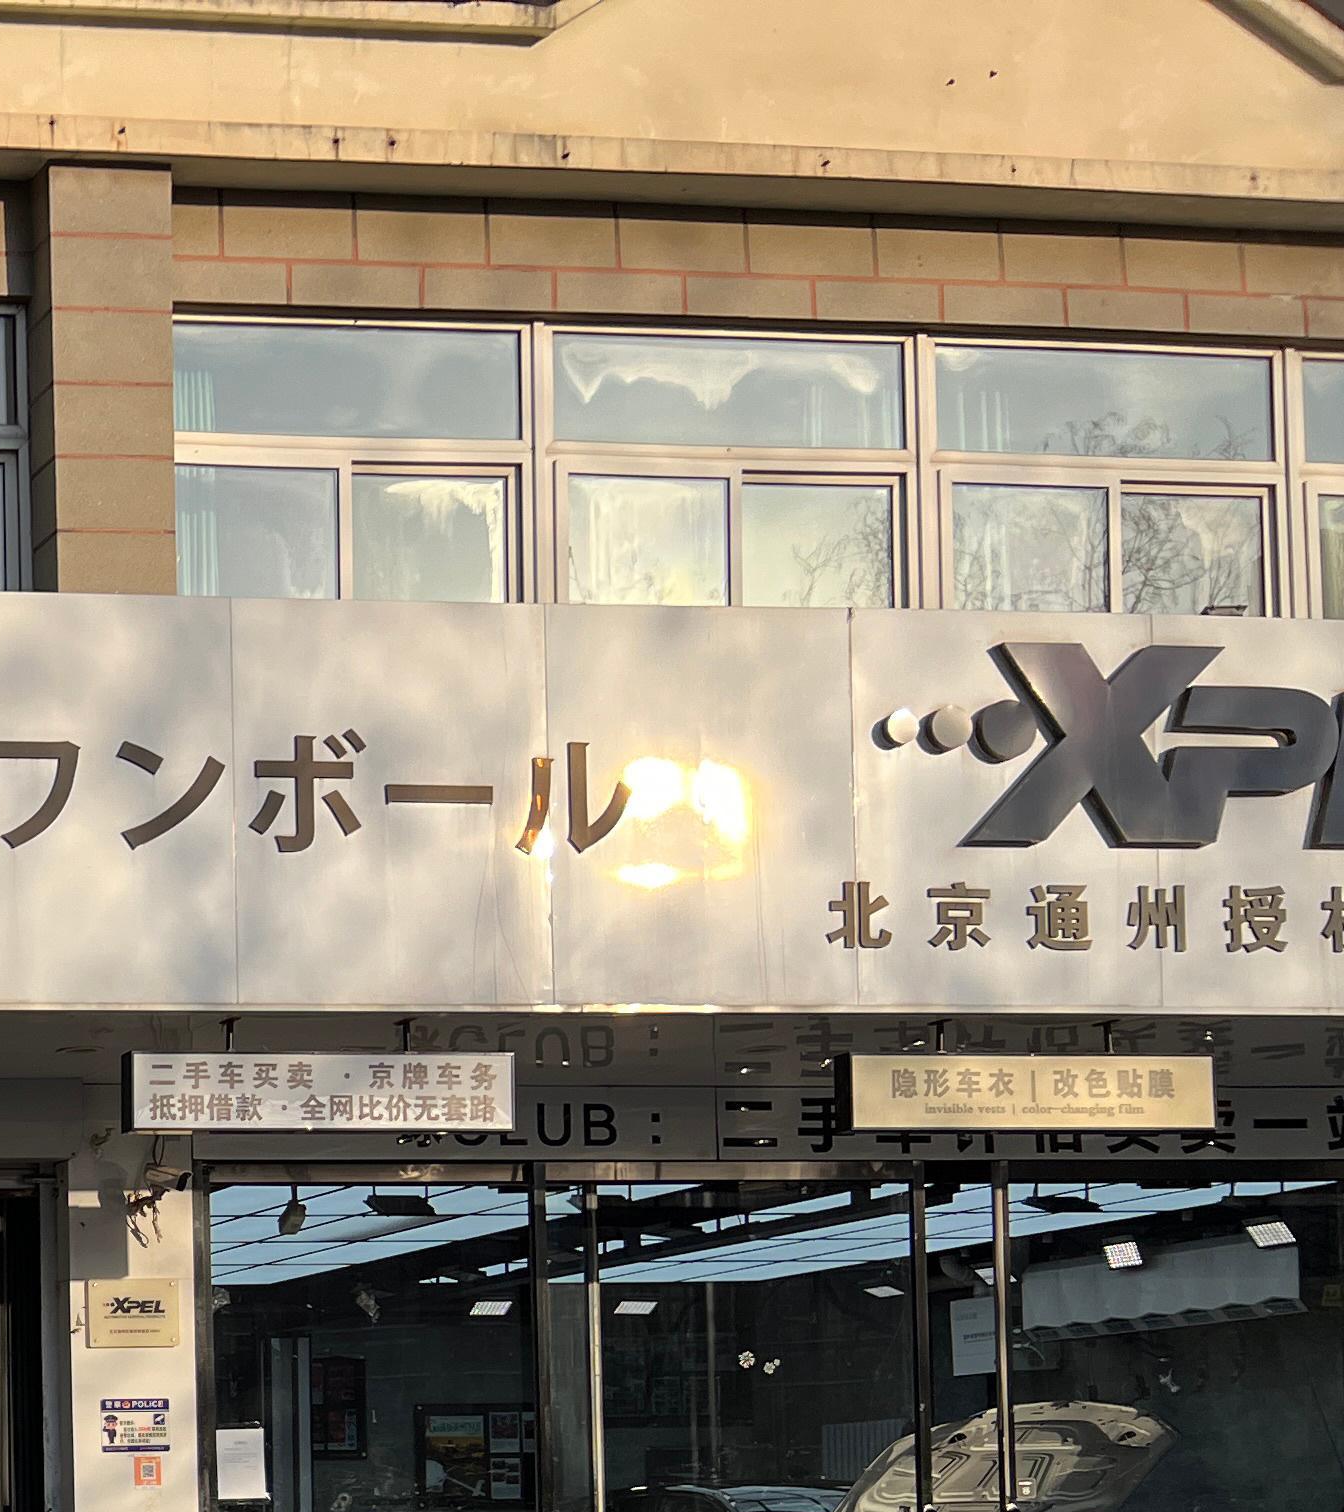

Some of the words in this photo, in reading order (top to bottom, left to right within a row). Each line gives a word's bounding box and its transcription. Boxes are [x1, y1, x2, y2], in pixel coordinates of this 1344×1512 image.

[149, 1062, 314, 1091] 二手车买卖
[368, 1062, 497, 1091] 京牌车务
[892, 1068, 1014, 1098] 隐形车衣
[1053, 1068, 1175, 1099] 改色贴膜
[149, 1094, 263, 1122] 抵押借款
[300, 1094, 496, 1122] 全网比价无套路
[924, 1103, 973, 1114] invisible
[978, 1105, 1006, 1114] vests
[1118, 1103, 1145, 1114] film
[110, 1297, 165, 1314] XPEL
